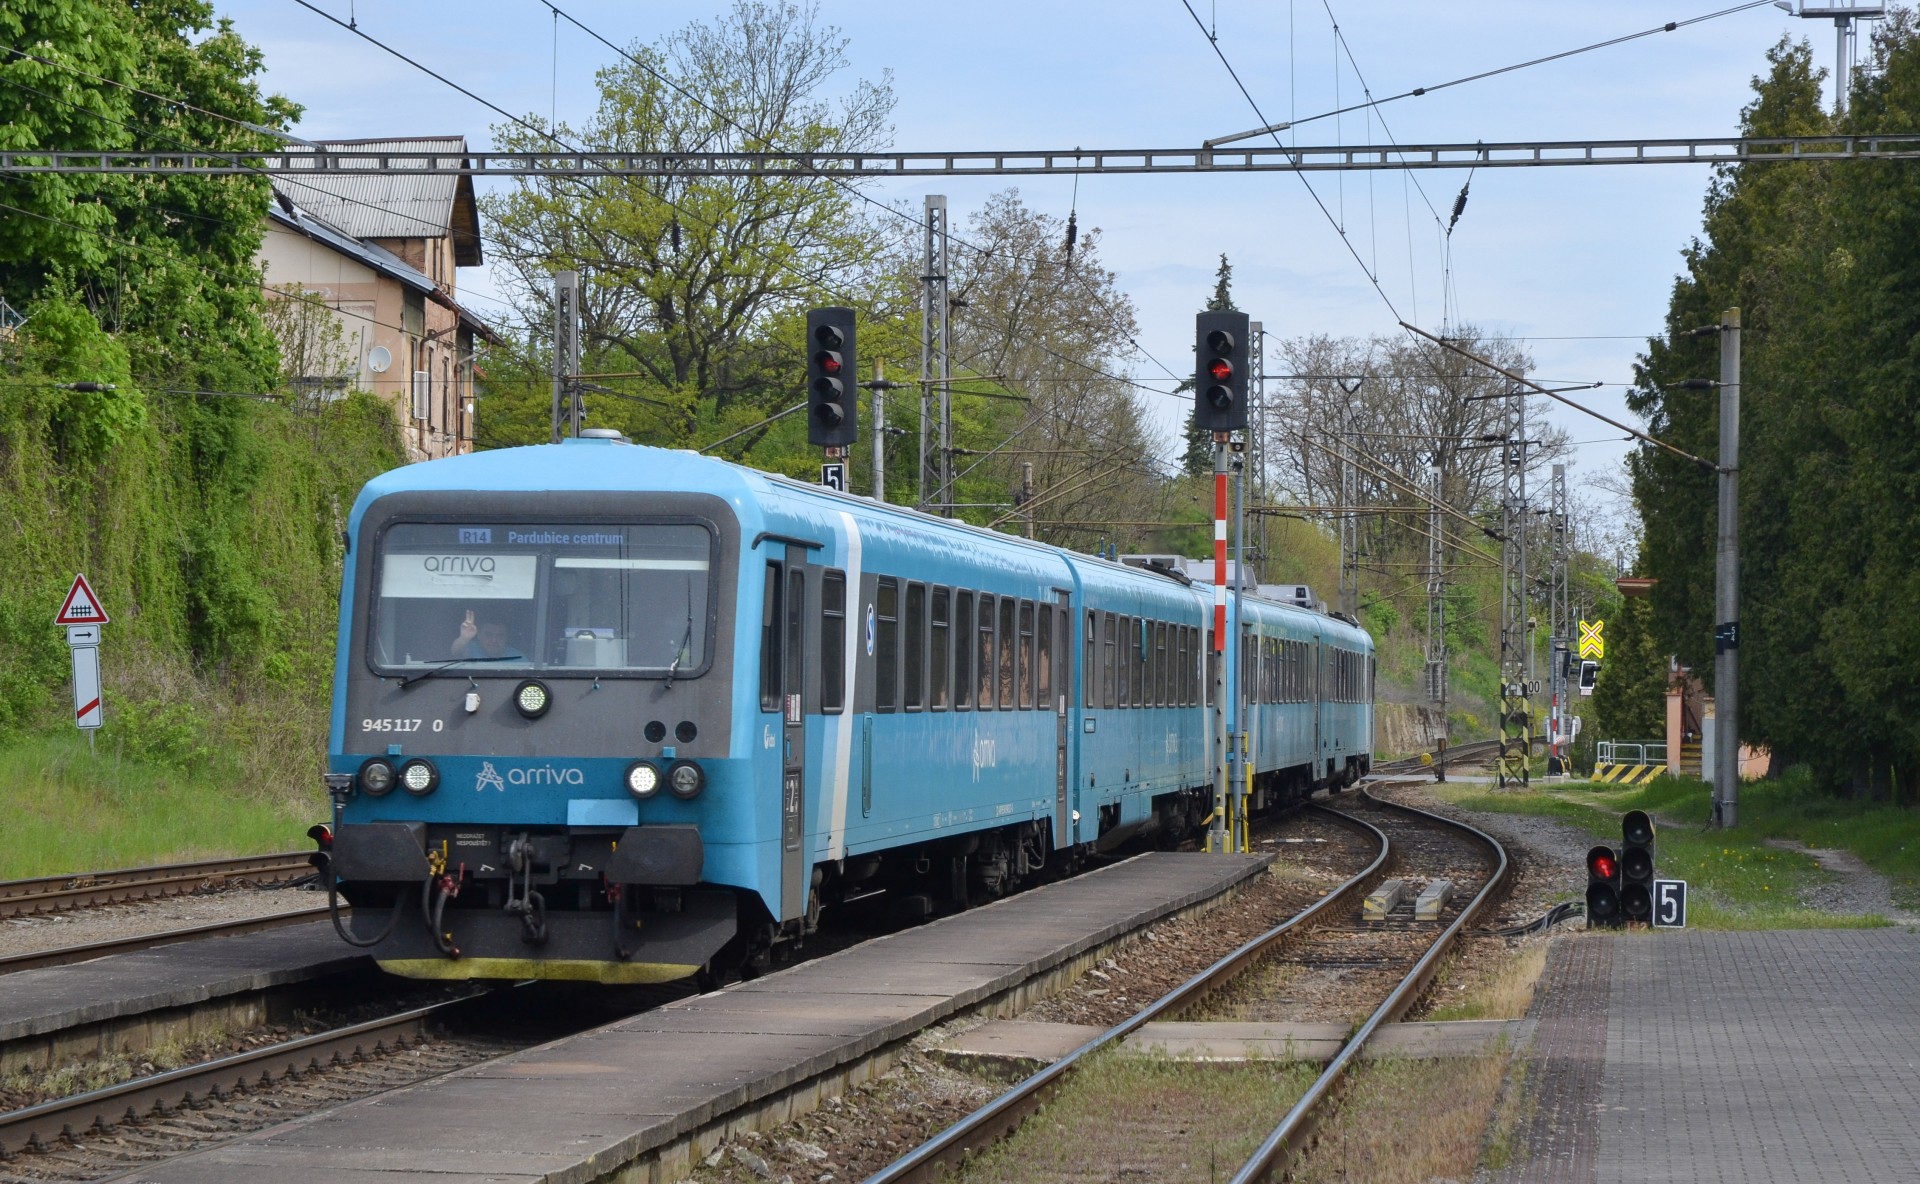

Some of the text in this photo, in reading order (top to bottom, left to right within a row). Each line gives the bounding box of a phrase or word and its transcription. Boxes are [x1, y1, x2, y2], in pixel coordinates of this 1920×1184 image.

[827, 467, 839, 491] 5
[463, 531, 624, 544] R14 Pardubice centrum
[424, 556, 496, 573] arriva
[1528, 680, 1540, 693] 00
[432, 719, 444, 732] 0
[508, 764, 584, 785] arriva
[1661, 884, 1677, 923] 5
